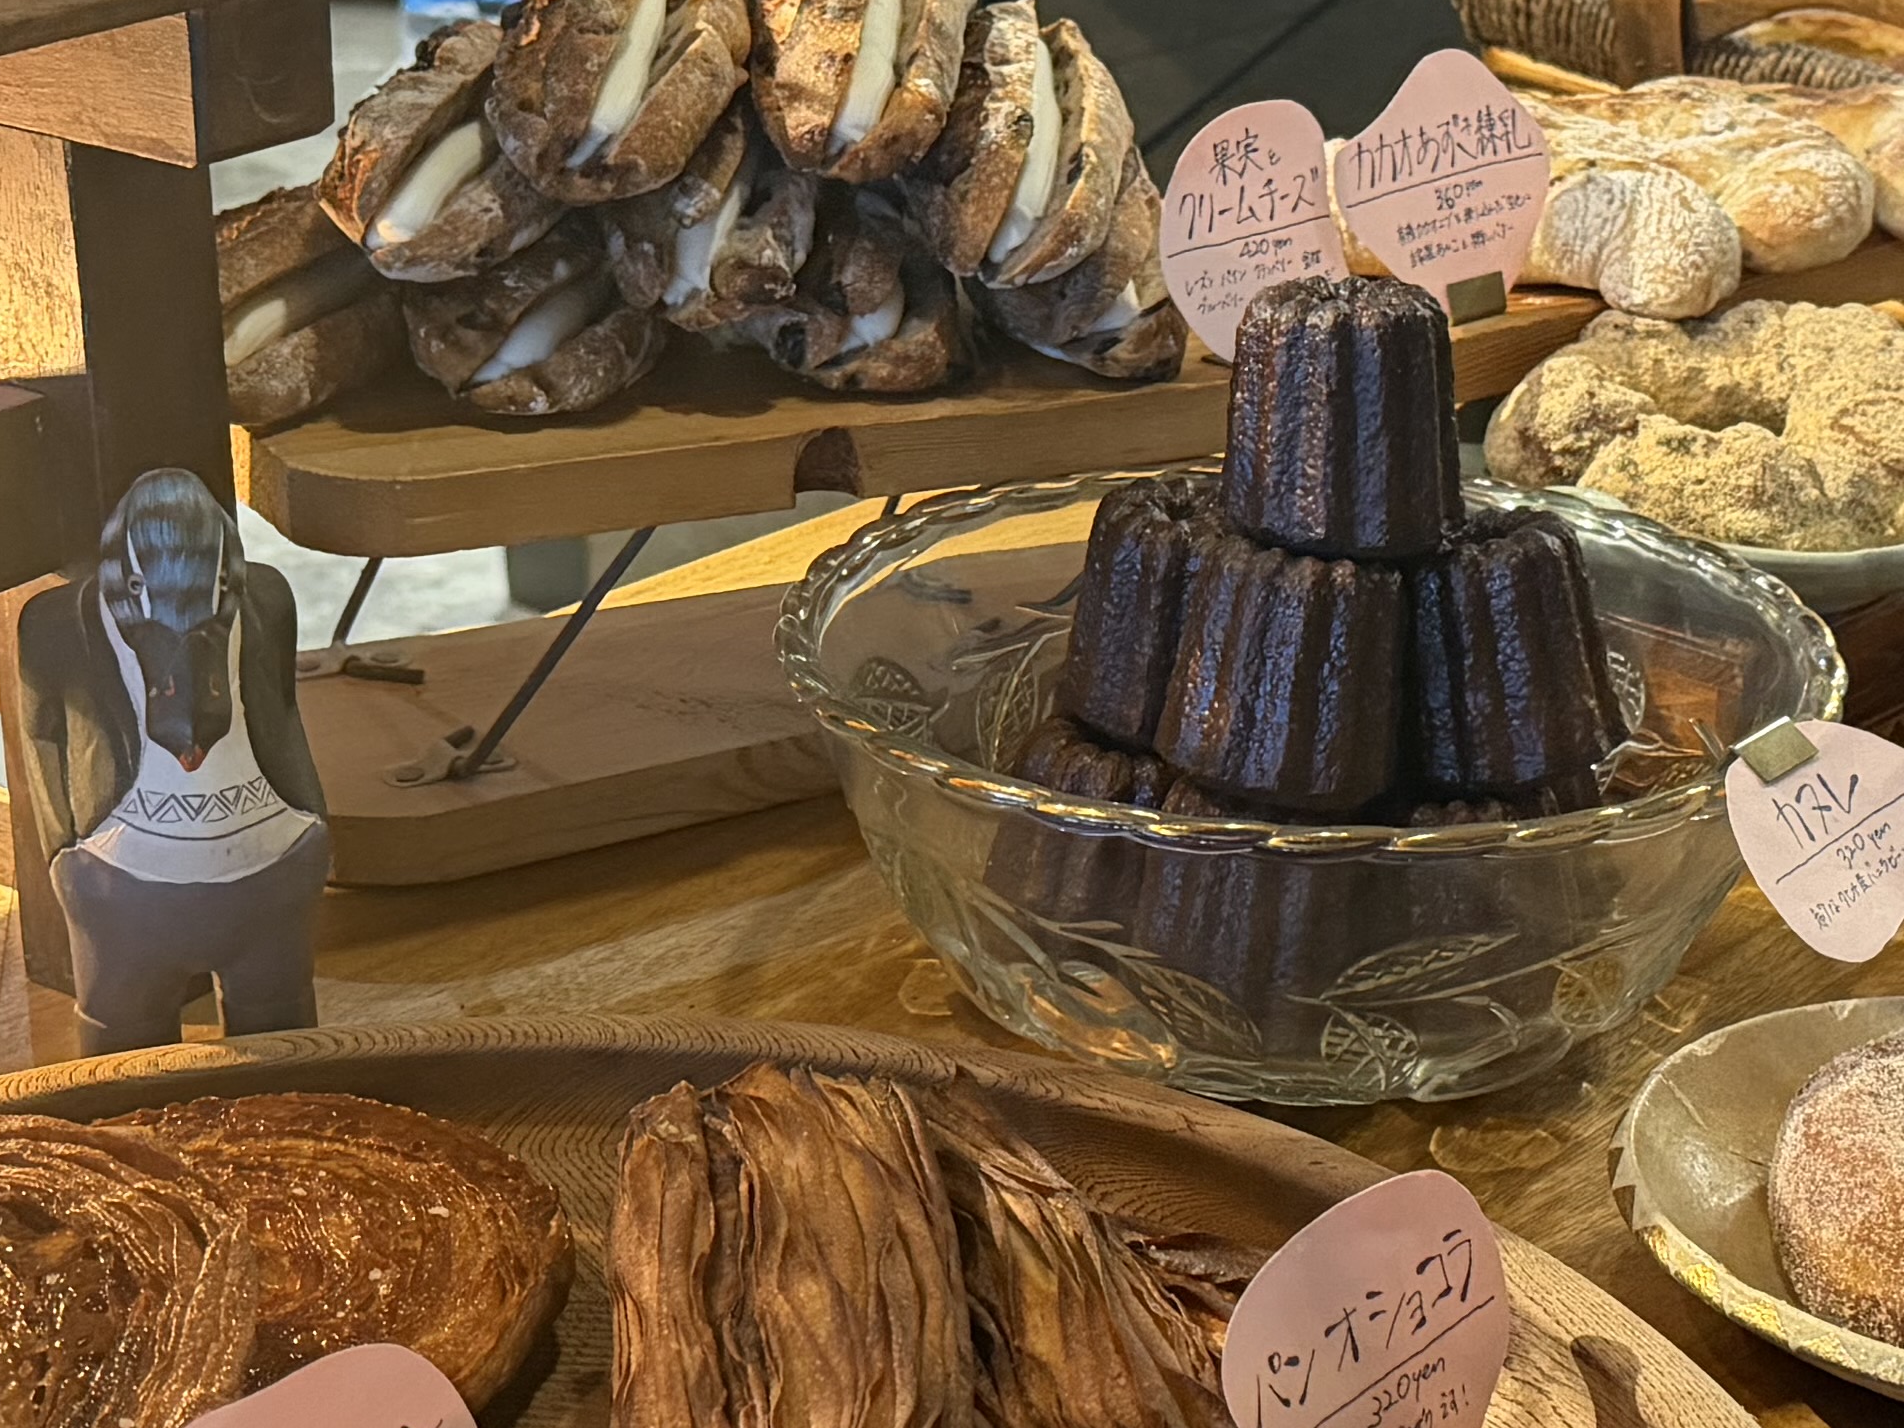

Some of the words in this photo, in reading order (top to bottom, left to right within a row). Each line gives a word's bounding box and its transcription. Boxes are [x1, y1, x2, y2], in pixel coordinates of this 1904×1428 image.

[1207, 128, 1282, 186] 果実と
[1178, 168, 1320, 240] クリームチーズ
[1238, 238, 1270, 258] 420
[1771, 772, 1860, 850] カヌレ
[1836, 832, 1866, 870] 320
